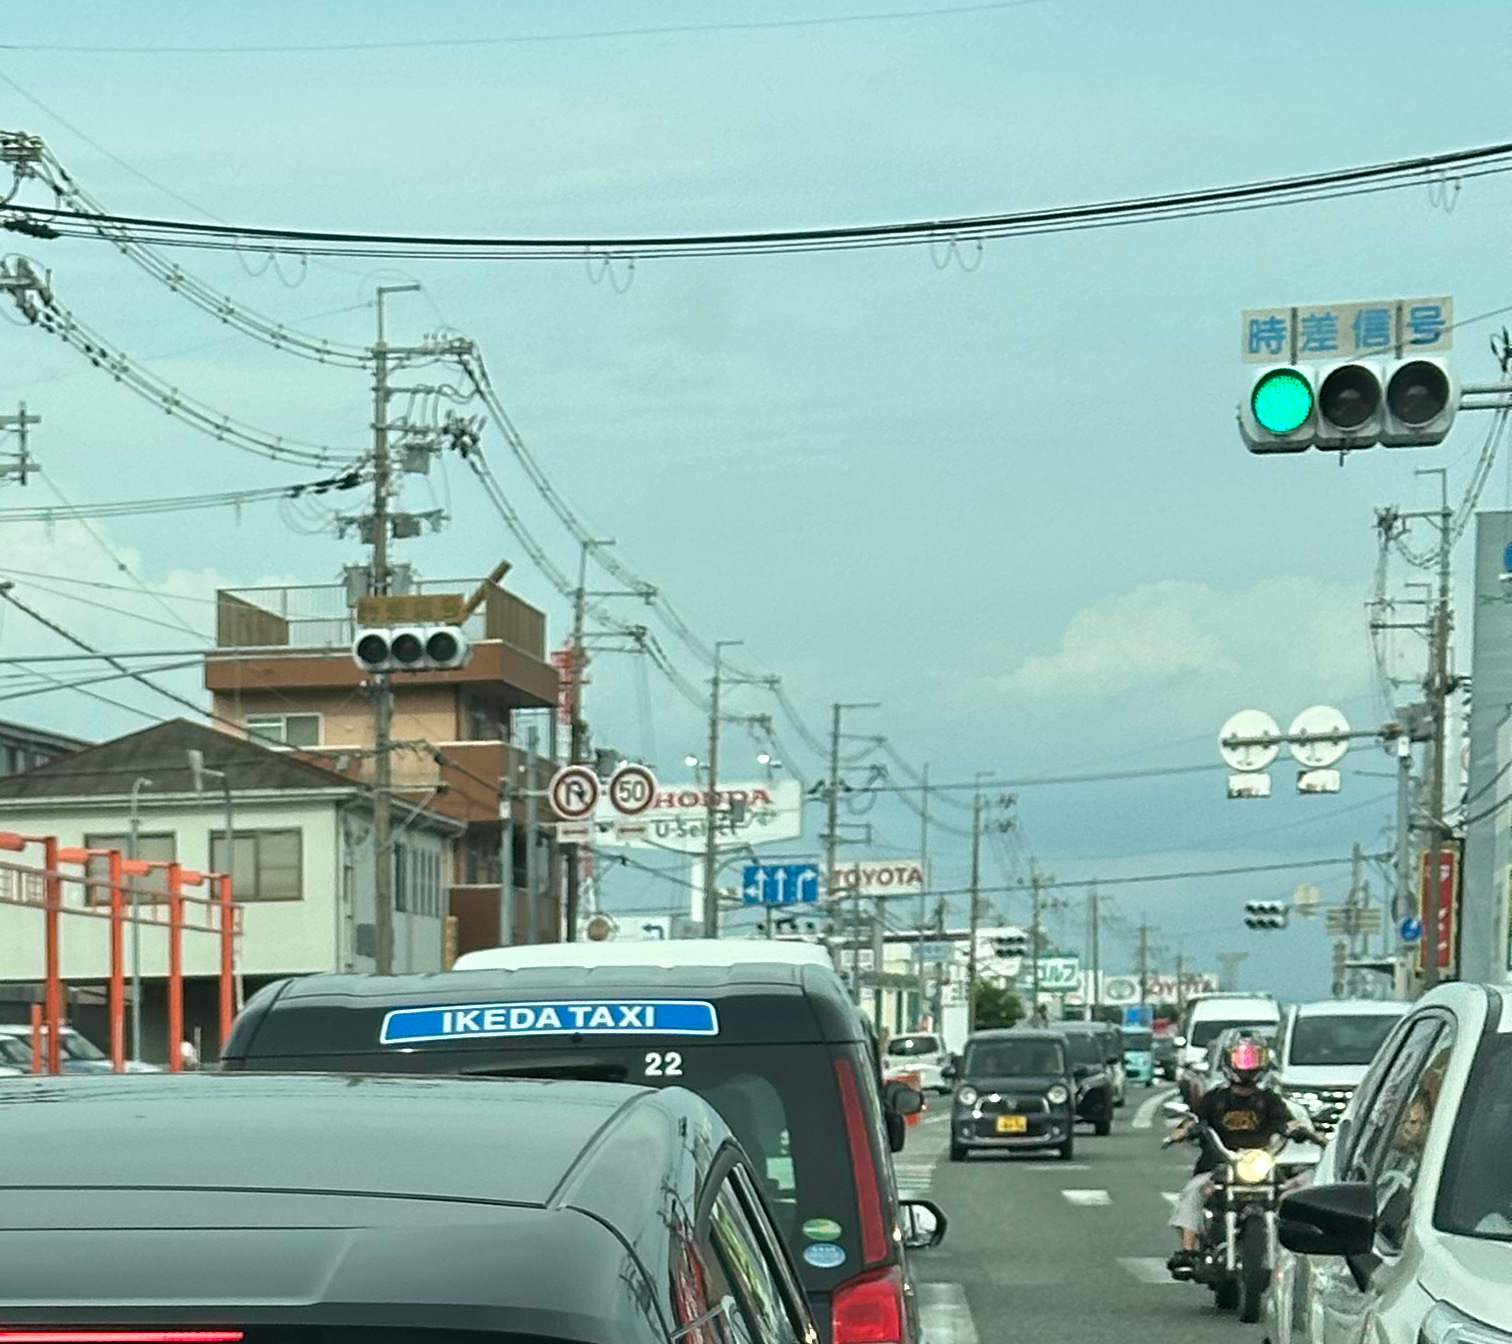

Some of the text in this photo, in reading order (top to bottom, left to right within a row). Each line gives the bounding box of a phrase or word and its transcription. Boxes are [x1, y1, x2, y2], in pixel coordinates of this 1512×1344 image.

[1248, 305, 1445, 355] 時差信号
[618, 780, 646, 803] 50
[832, 866, 923, 886] TOYOTA
[442, 1005, 655, 1034] IKEDA TAXI
[644, 1051, 683, 1077] 22
